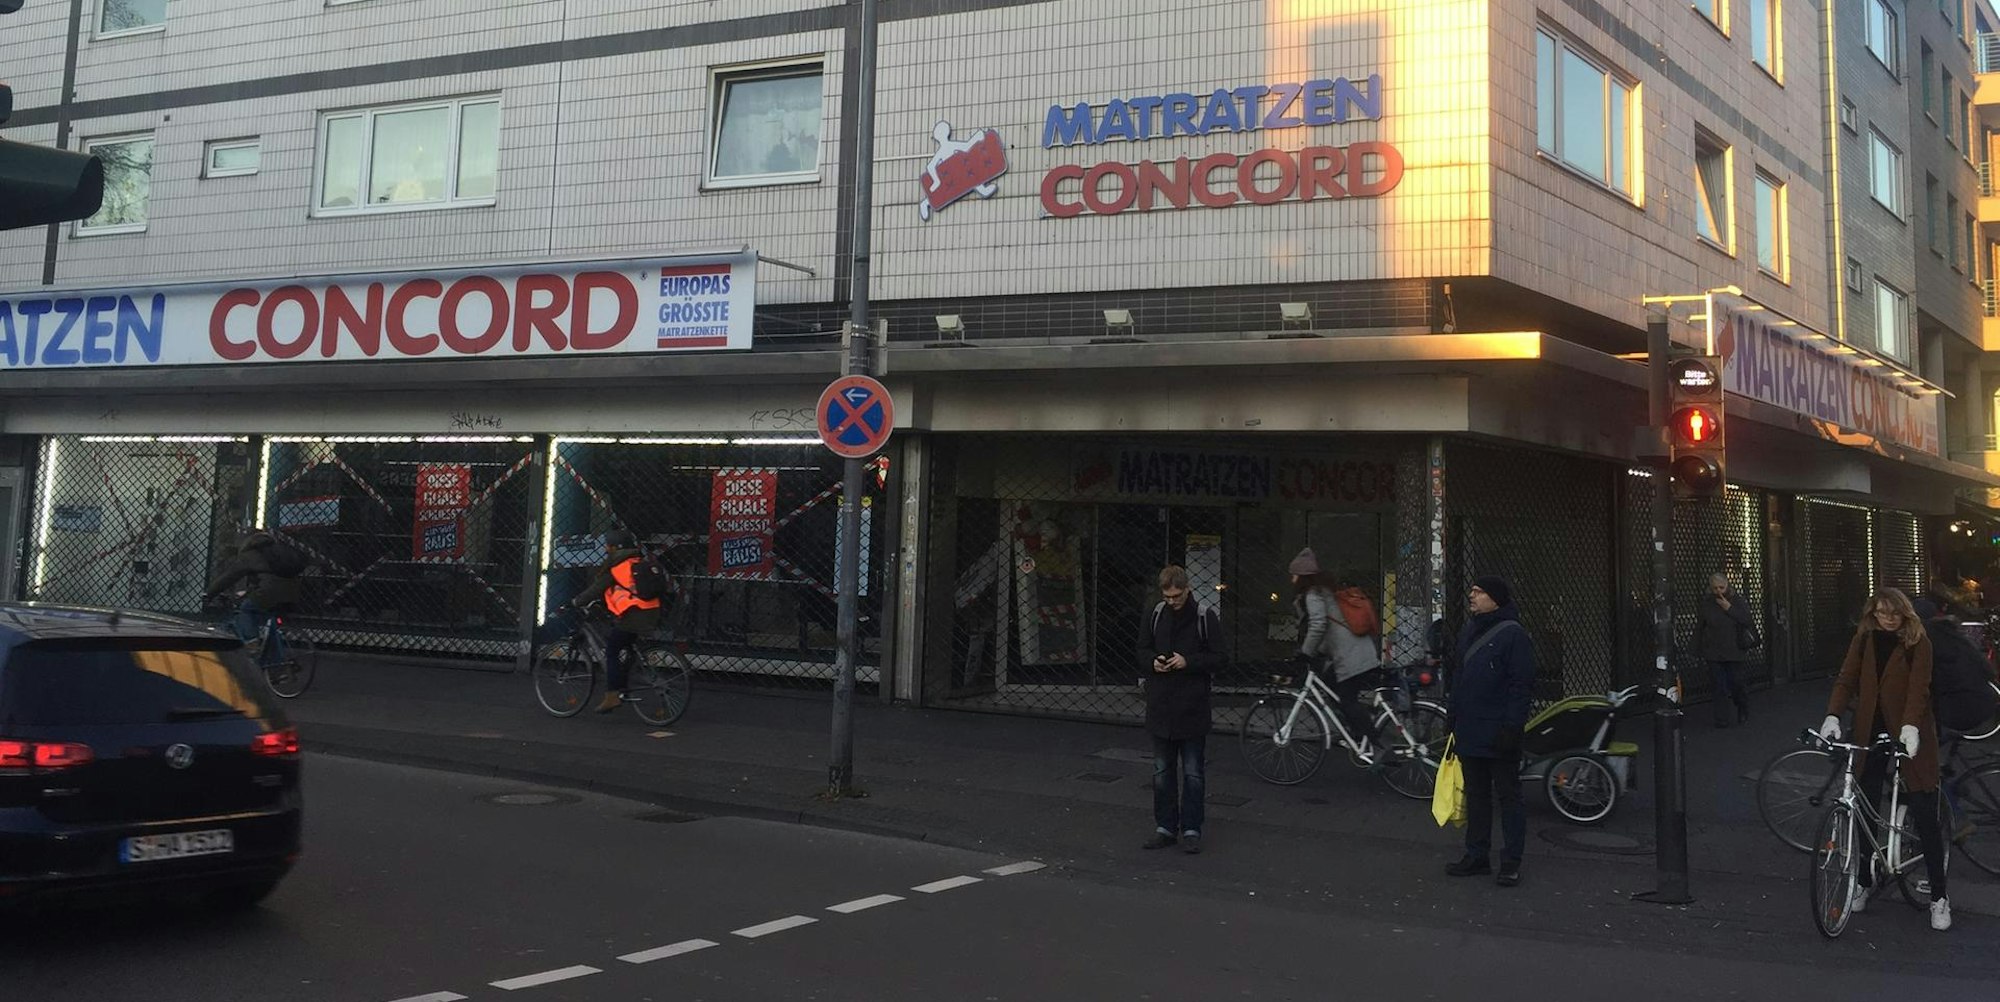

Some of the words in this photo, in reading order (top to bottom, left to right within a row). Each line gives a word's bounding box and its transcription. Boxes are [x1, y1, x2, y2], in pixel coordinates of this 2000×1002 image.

[1043, 73, 1383, 149] MATRATZEN
[1040, 141, 1405, 218] CONCORD
[660, 274, 731, 297] EUROPAS
[209, 270, 639, 361] CONCORD
[657, 325, 729, 337] MATRATZENKETTE
[659, 296, 730, 324] GRÖSSTE
[1736, 314, 1849, 426] MATRATZEN
[725, 479, 763, 496] DIESE
[1117, 451, 1272, 498] MATRATZEN
